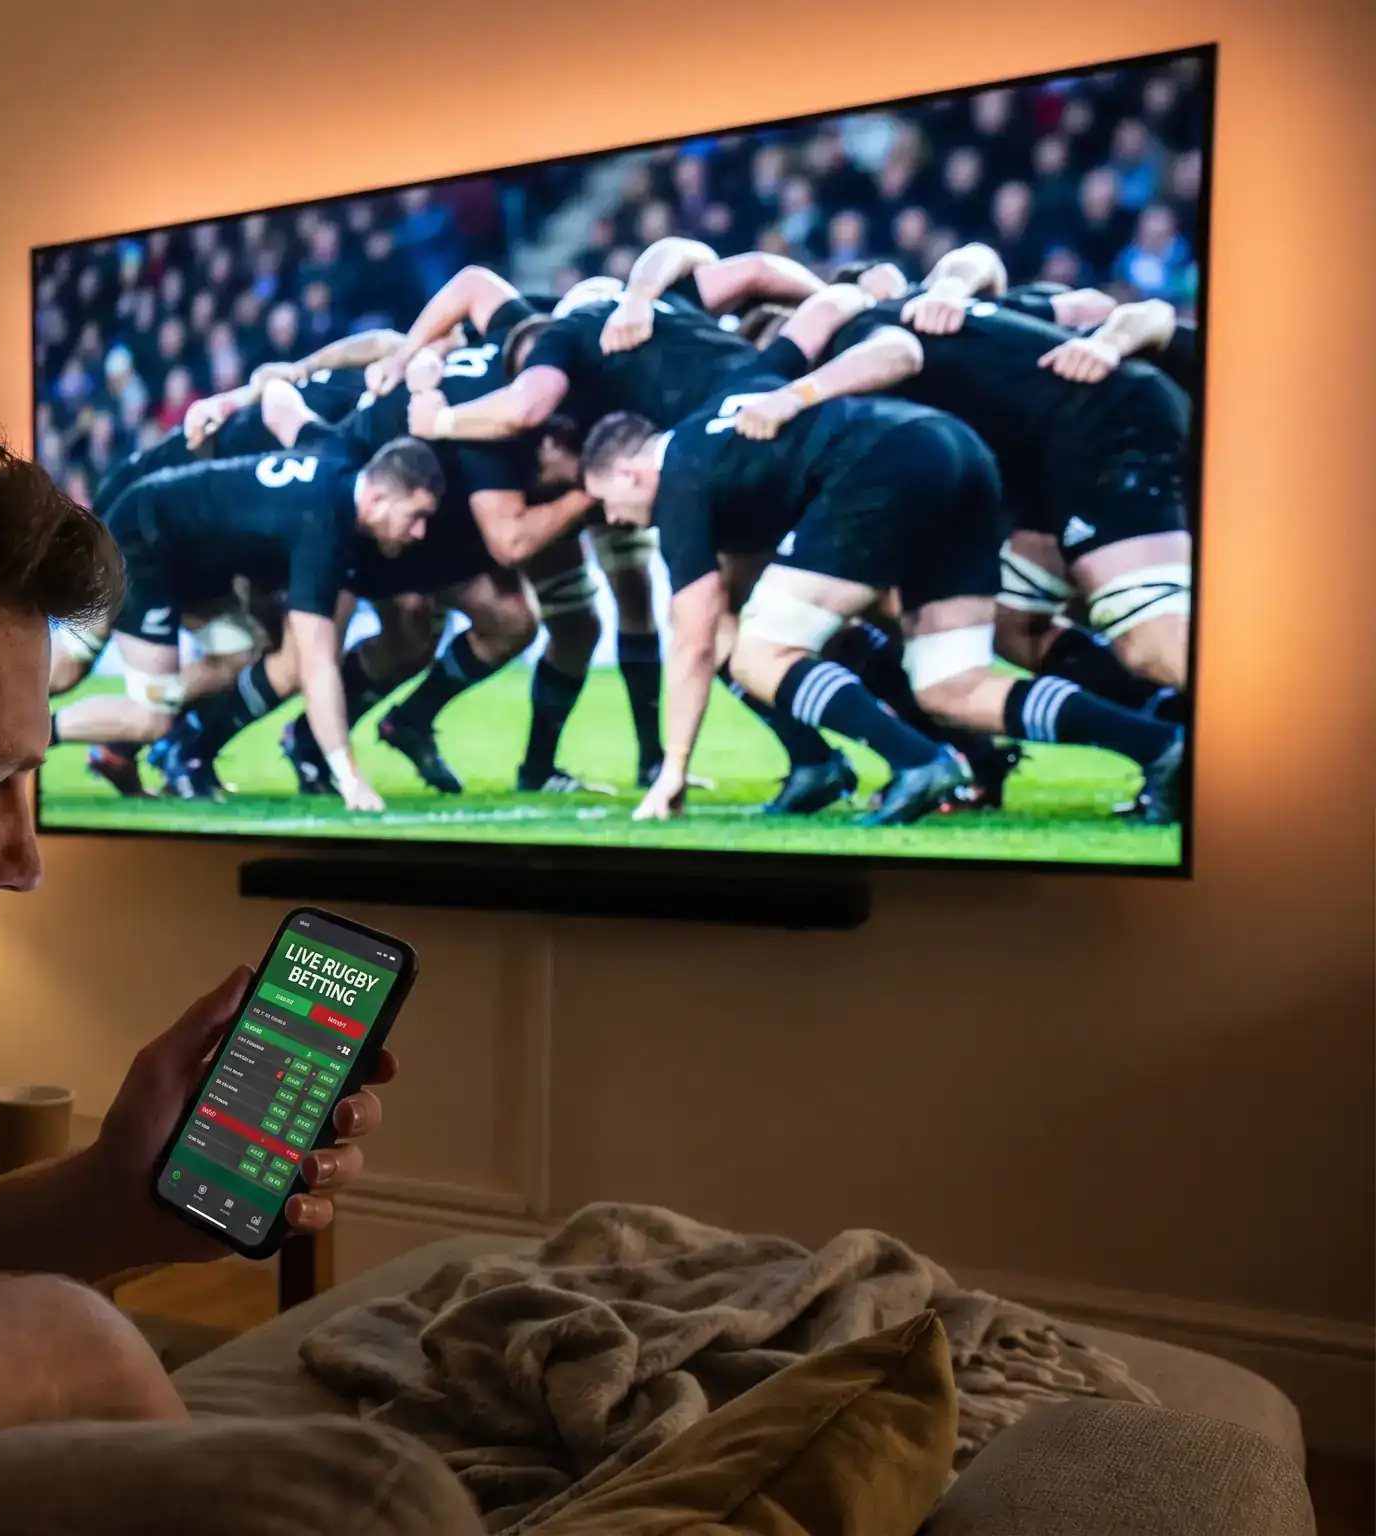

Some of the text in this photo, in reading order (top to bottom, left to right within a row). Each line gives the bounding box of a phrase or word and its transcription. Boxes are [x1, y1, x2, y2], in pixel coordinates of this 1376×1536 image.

[255, 455, 319, 488] 3
[284, 943, 380, 992] LIVE RUGBY
[287, 965, 358, 1007] BETTING
